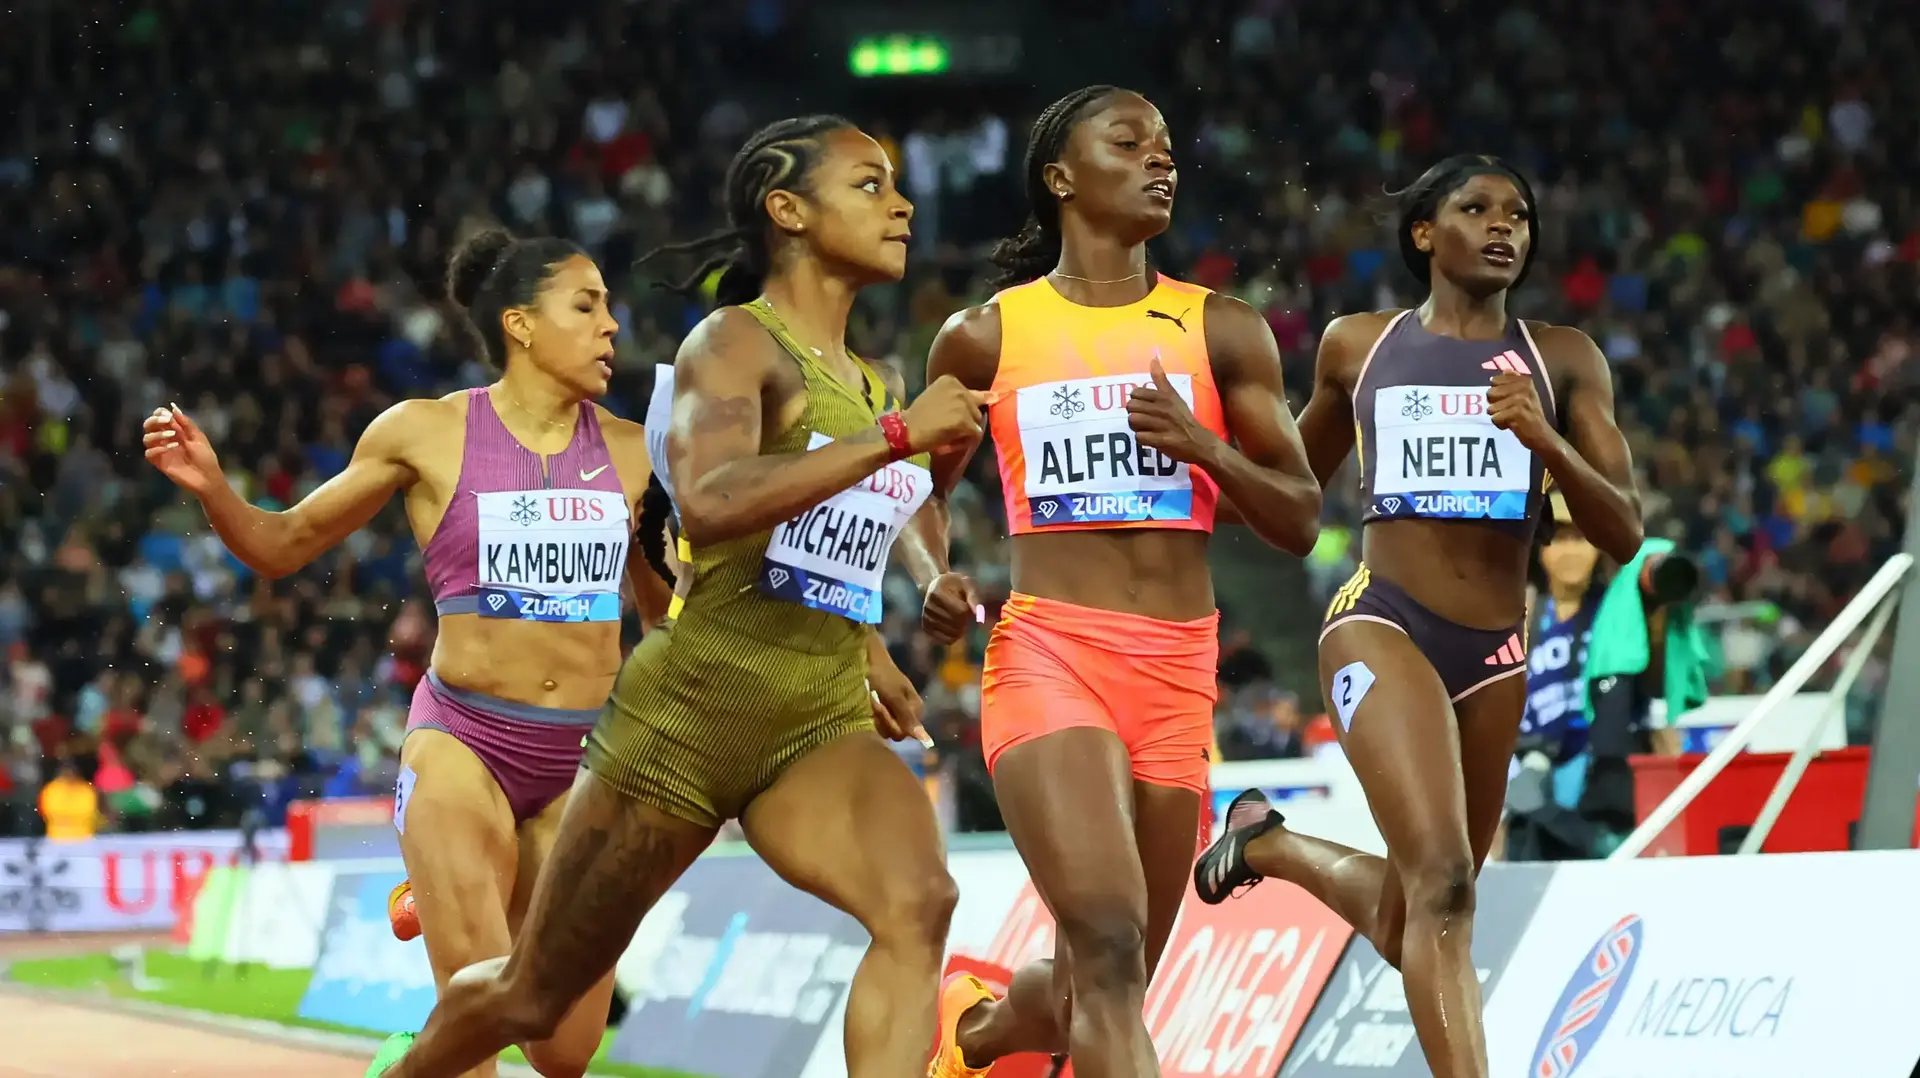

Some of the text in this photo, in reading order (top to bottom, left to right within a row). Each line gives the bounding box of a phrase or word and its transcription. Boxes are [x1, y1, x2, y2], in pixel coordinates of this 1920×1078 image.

[1439, 393, 1484, 416] UB
[1402, 436, 1503, 479] NEITA
[869, 466, 917, 504] UBS
[546, 497, 605, 522] UBS
[1071, 495, 1153, 516] ZURICH
[1414, 495, 1491, 513] ZURICH
[487, 541, 623, 584] KAMBUNDJI
[519, 596, 590, 617] ZURICH
[802, 577, 871, 614] ZURICH
[1342, 674, 1353, 708] 2
[1142, 925, 1328, 1077] OMEGA
[1625, 975, 1795, 1038] MEDICA
